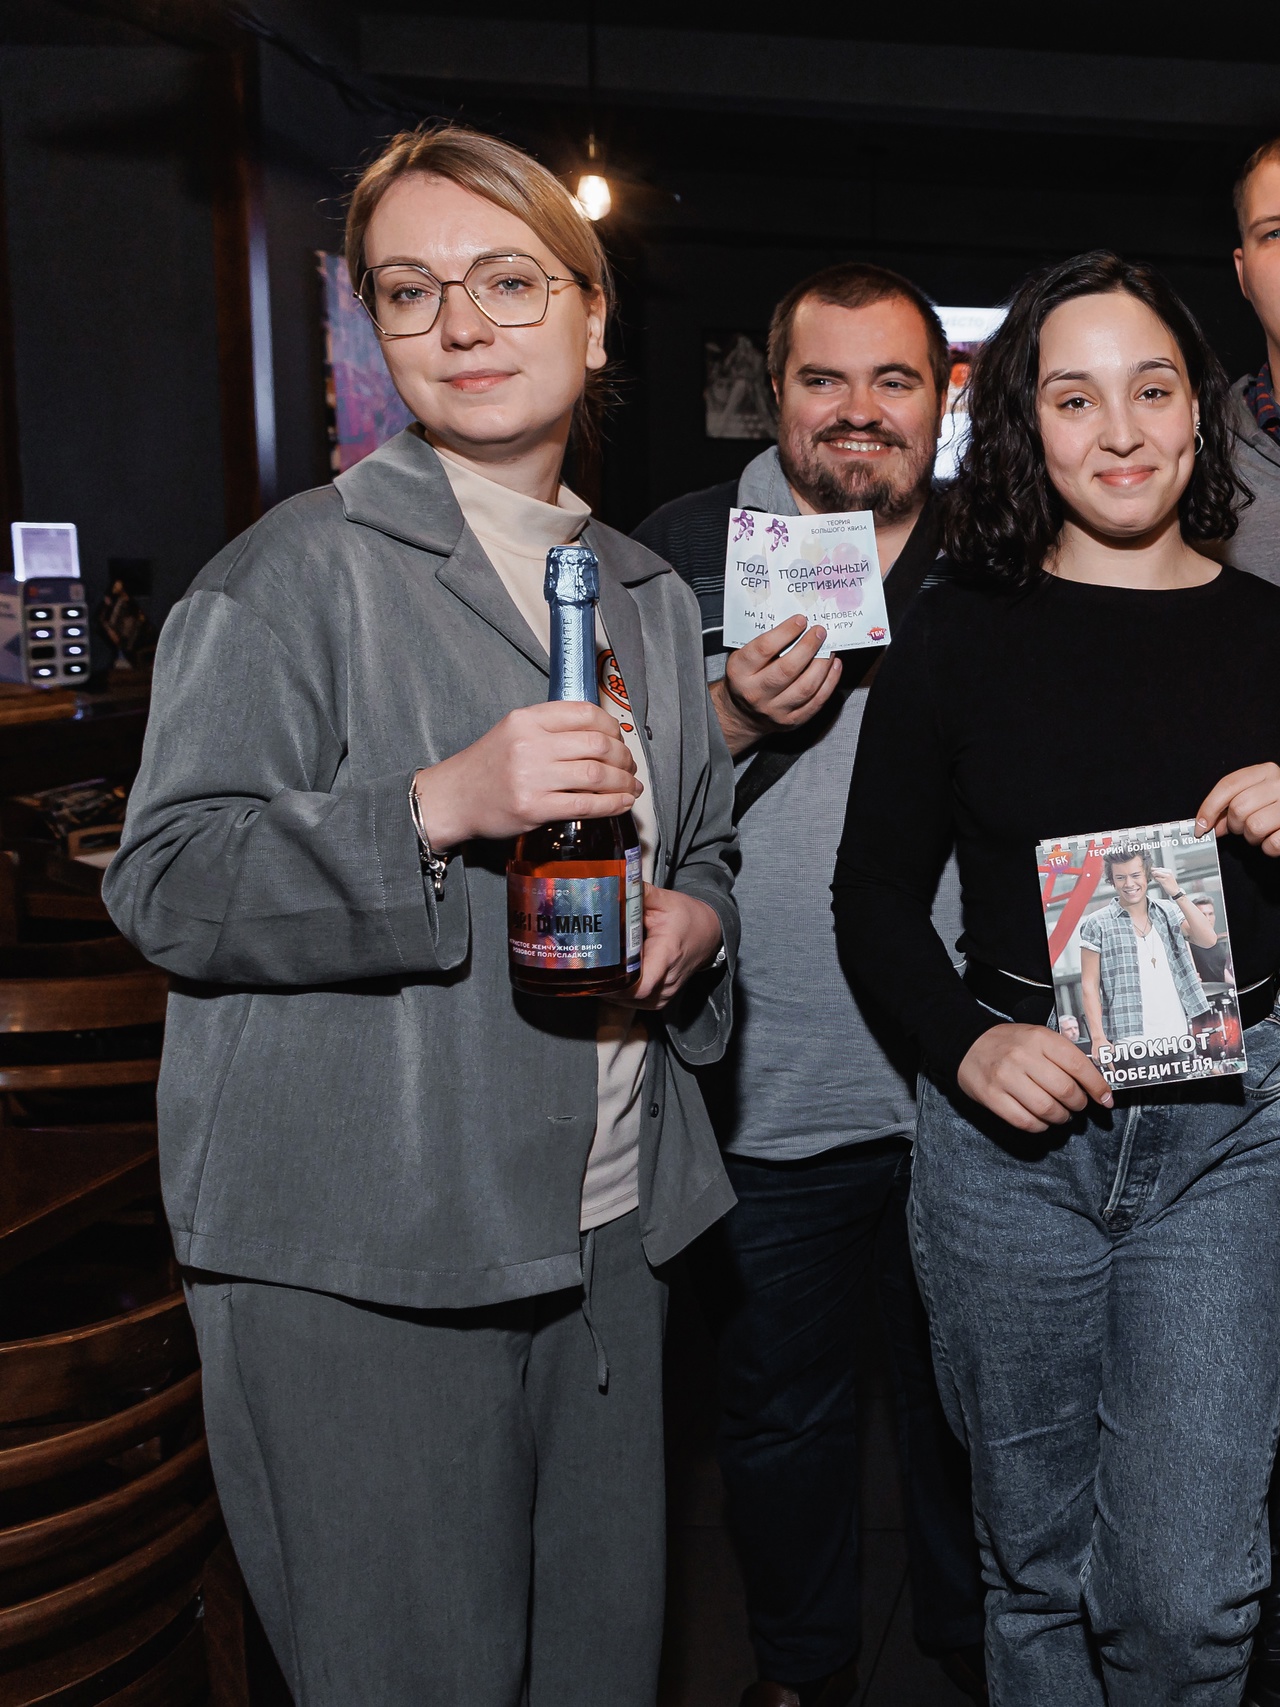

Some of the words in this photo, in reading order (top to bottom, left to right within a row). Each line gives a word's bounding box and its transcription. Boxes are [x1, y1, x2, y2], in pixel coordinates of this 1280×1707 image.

[826, 518, 851, 527] ТЕОРИЯ
[811, 526, 846, 535] БОЛЬШОГО
[847, 525, 868, 533] КВИЗА
[736, 561, 769, 576] ПОД
[778, 559, 870, 580] ПОДАРОЧНЫЙ
[787, 577, 865, 594] СЕРТИФИКАТ
[744, 610, 756, 618] НА
[820, 610, 864, 620] ЧЕЛОВЕКА
[754, 622, 766, 630] НА
[833, 621, 854, 630] ИГРУ
[870, 630, 884, 638] ТБК
[562, 618, 574, 697] FRIZZANTE
[1088, 845, 1124, 858] ТЕОРИЯ
[1127, 839, 1179, 853] БОЛЬШОГО
[1182, 836, 1211, 846] КВИЗА
[1049, 855, 1069, 867] ТБК
[556, 914, 603, 934] MARE
[531, 944, 579, 952] ЖЕМЧУЖНОЕ
[1098, 1032, 1210, 1065] БЛОКНОТ
[1103, 1056, 1214, 1084] ПОБЕДИТЕЛЯ
